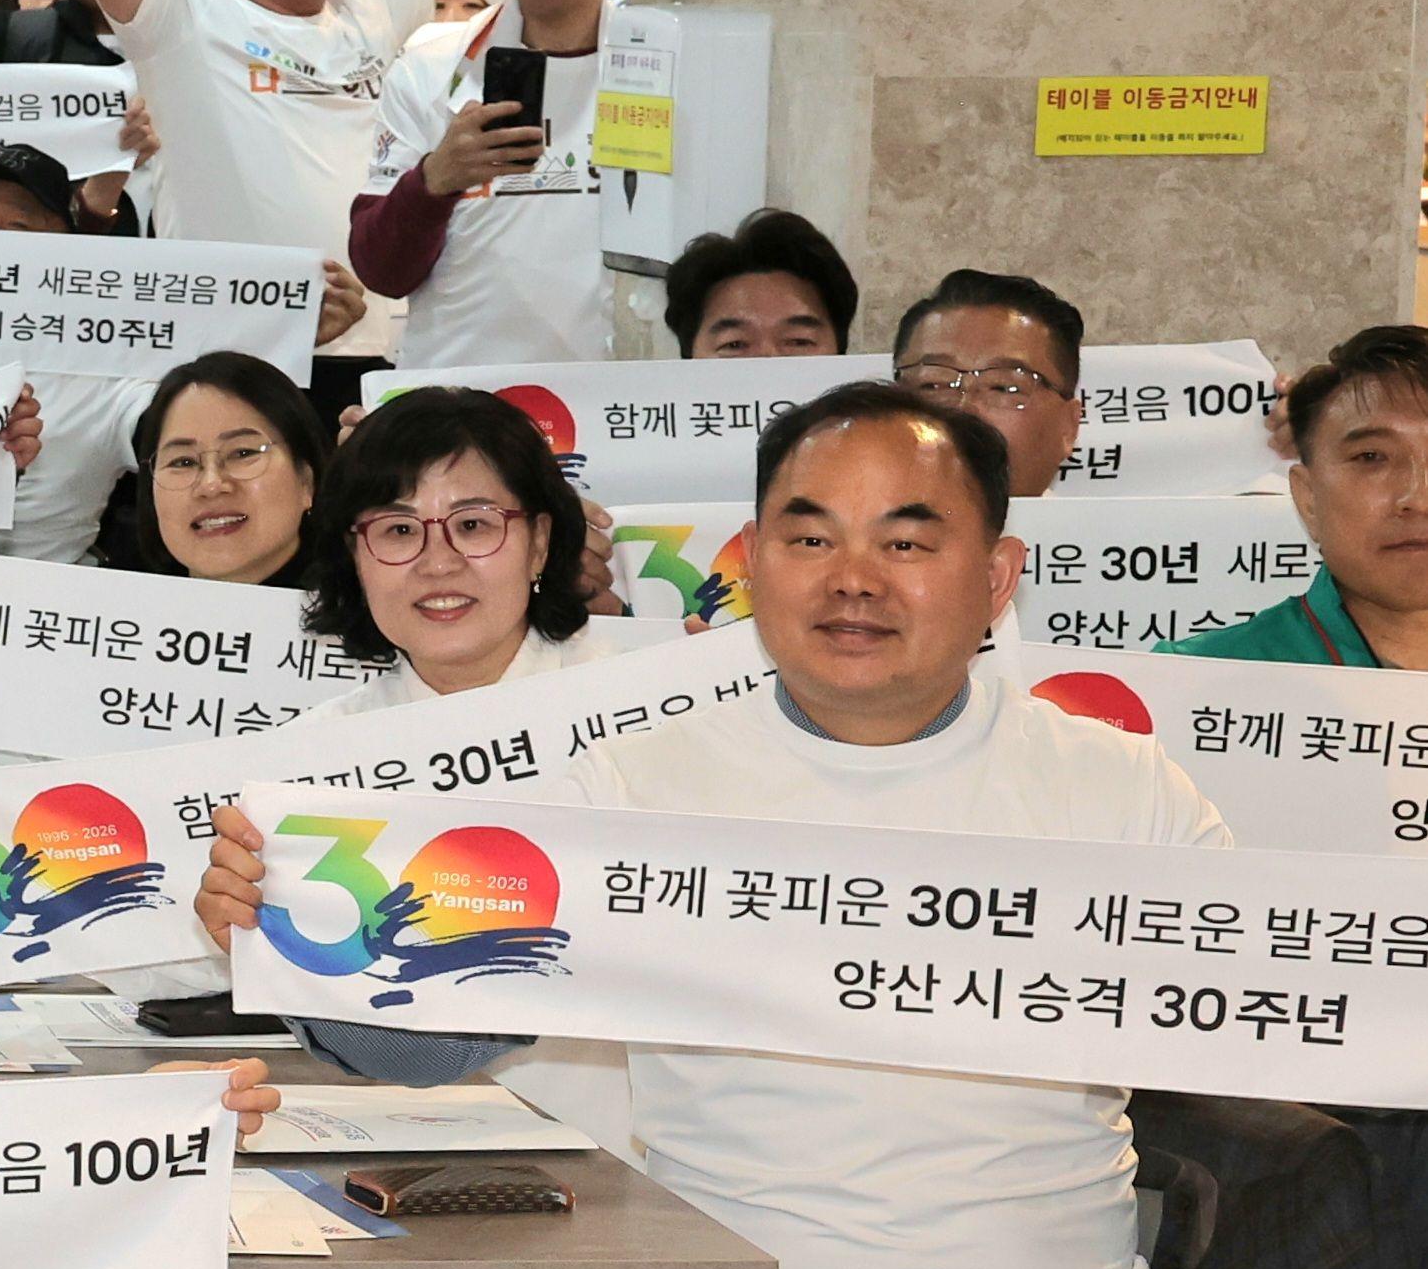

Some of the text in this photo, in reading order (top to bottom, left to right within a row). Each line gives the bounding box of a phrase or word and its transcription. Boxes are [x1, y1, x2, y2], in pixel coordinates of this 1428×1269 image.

[1047, 87, 1258, 110] 테이블 이동금지안내
[39, 267, 122, 299] 새로운
[134, 272, 218, 305] 발걸음
[230, 280, 310, 309] 100년
[1101, 542, 1198, 583] 30년
[25, 610, 142, 660] 꽃피운
[156, 628, 251, 673] 30년
[1192, 706, 1284, 758] 함께
[431, 872, 529, 892] 1996 2026
[431, 890, 527, 915] Yangsan
[604, 861, 706, 918] 함께
[727, 871, 888, 927] 꽃피운
[907, 885, 1037, 938] 30년
[1075, 895, 1244, 954] 새로운
[65, 1127, 209, 1186] 100년
